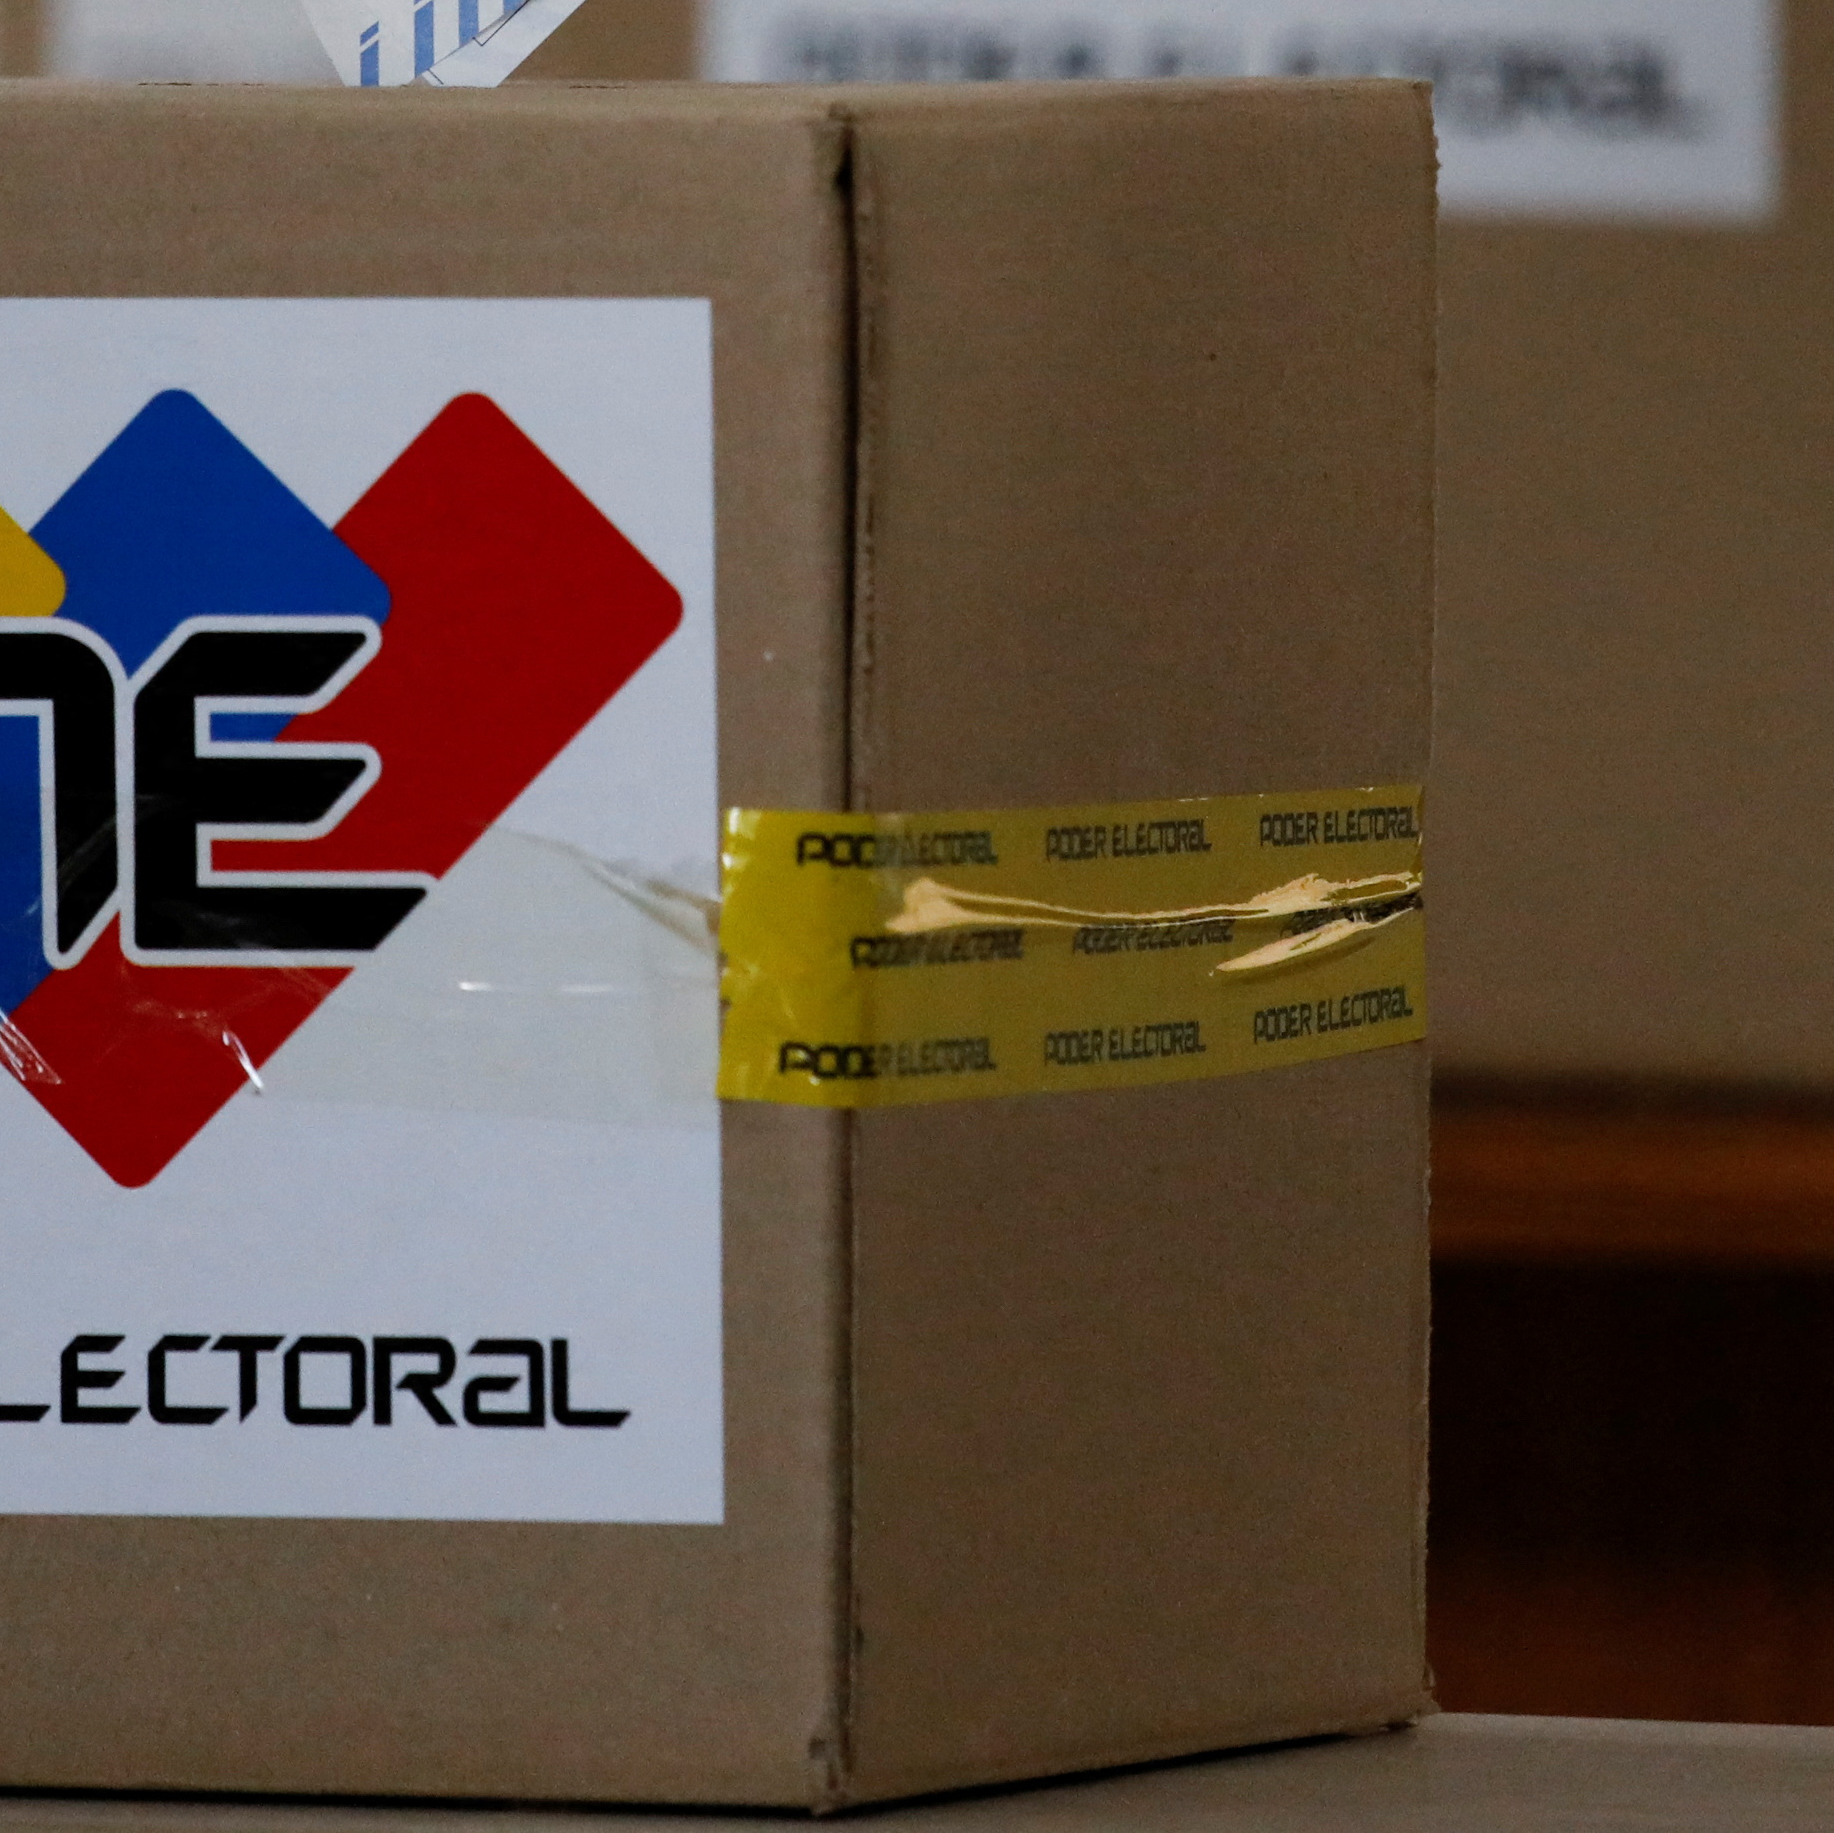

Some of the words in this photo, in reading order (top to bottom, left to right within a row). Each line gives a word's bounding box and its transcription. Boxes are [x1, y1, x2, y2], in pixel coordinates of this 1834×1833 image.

[1045, 824, 1107, 862] PODER
[1112, 818, 1212, 858] ELECTORAL
[1260, 811, 1318, 847] PODER
[1323, 805, 1419, 843] ELECTORAL
[1253, 1003, 1311, 1044] PODER
[1317, 985, 1413, 1032] ELECTORAL
[1044, 1029, 1104, 1065] PODER
[1108, 1020, 1206, 1060] ELECTORAL
